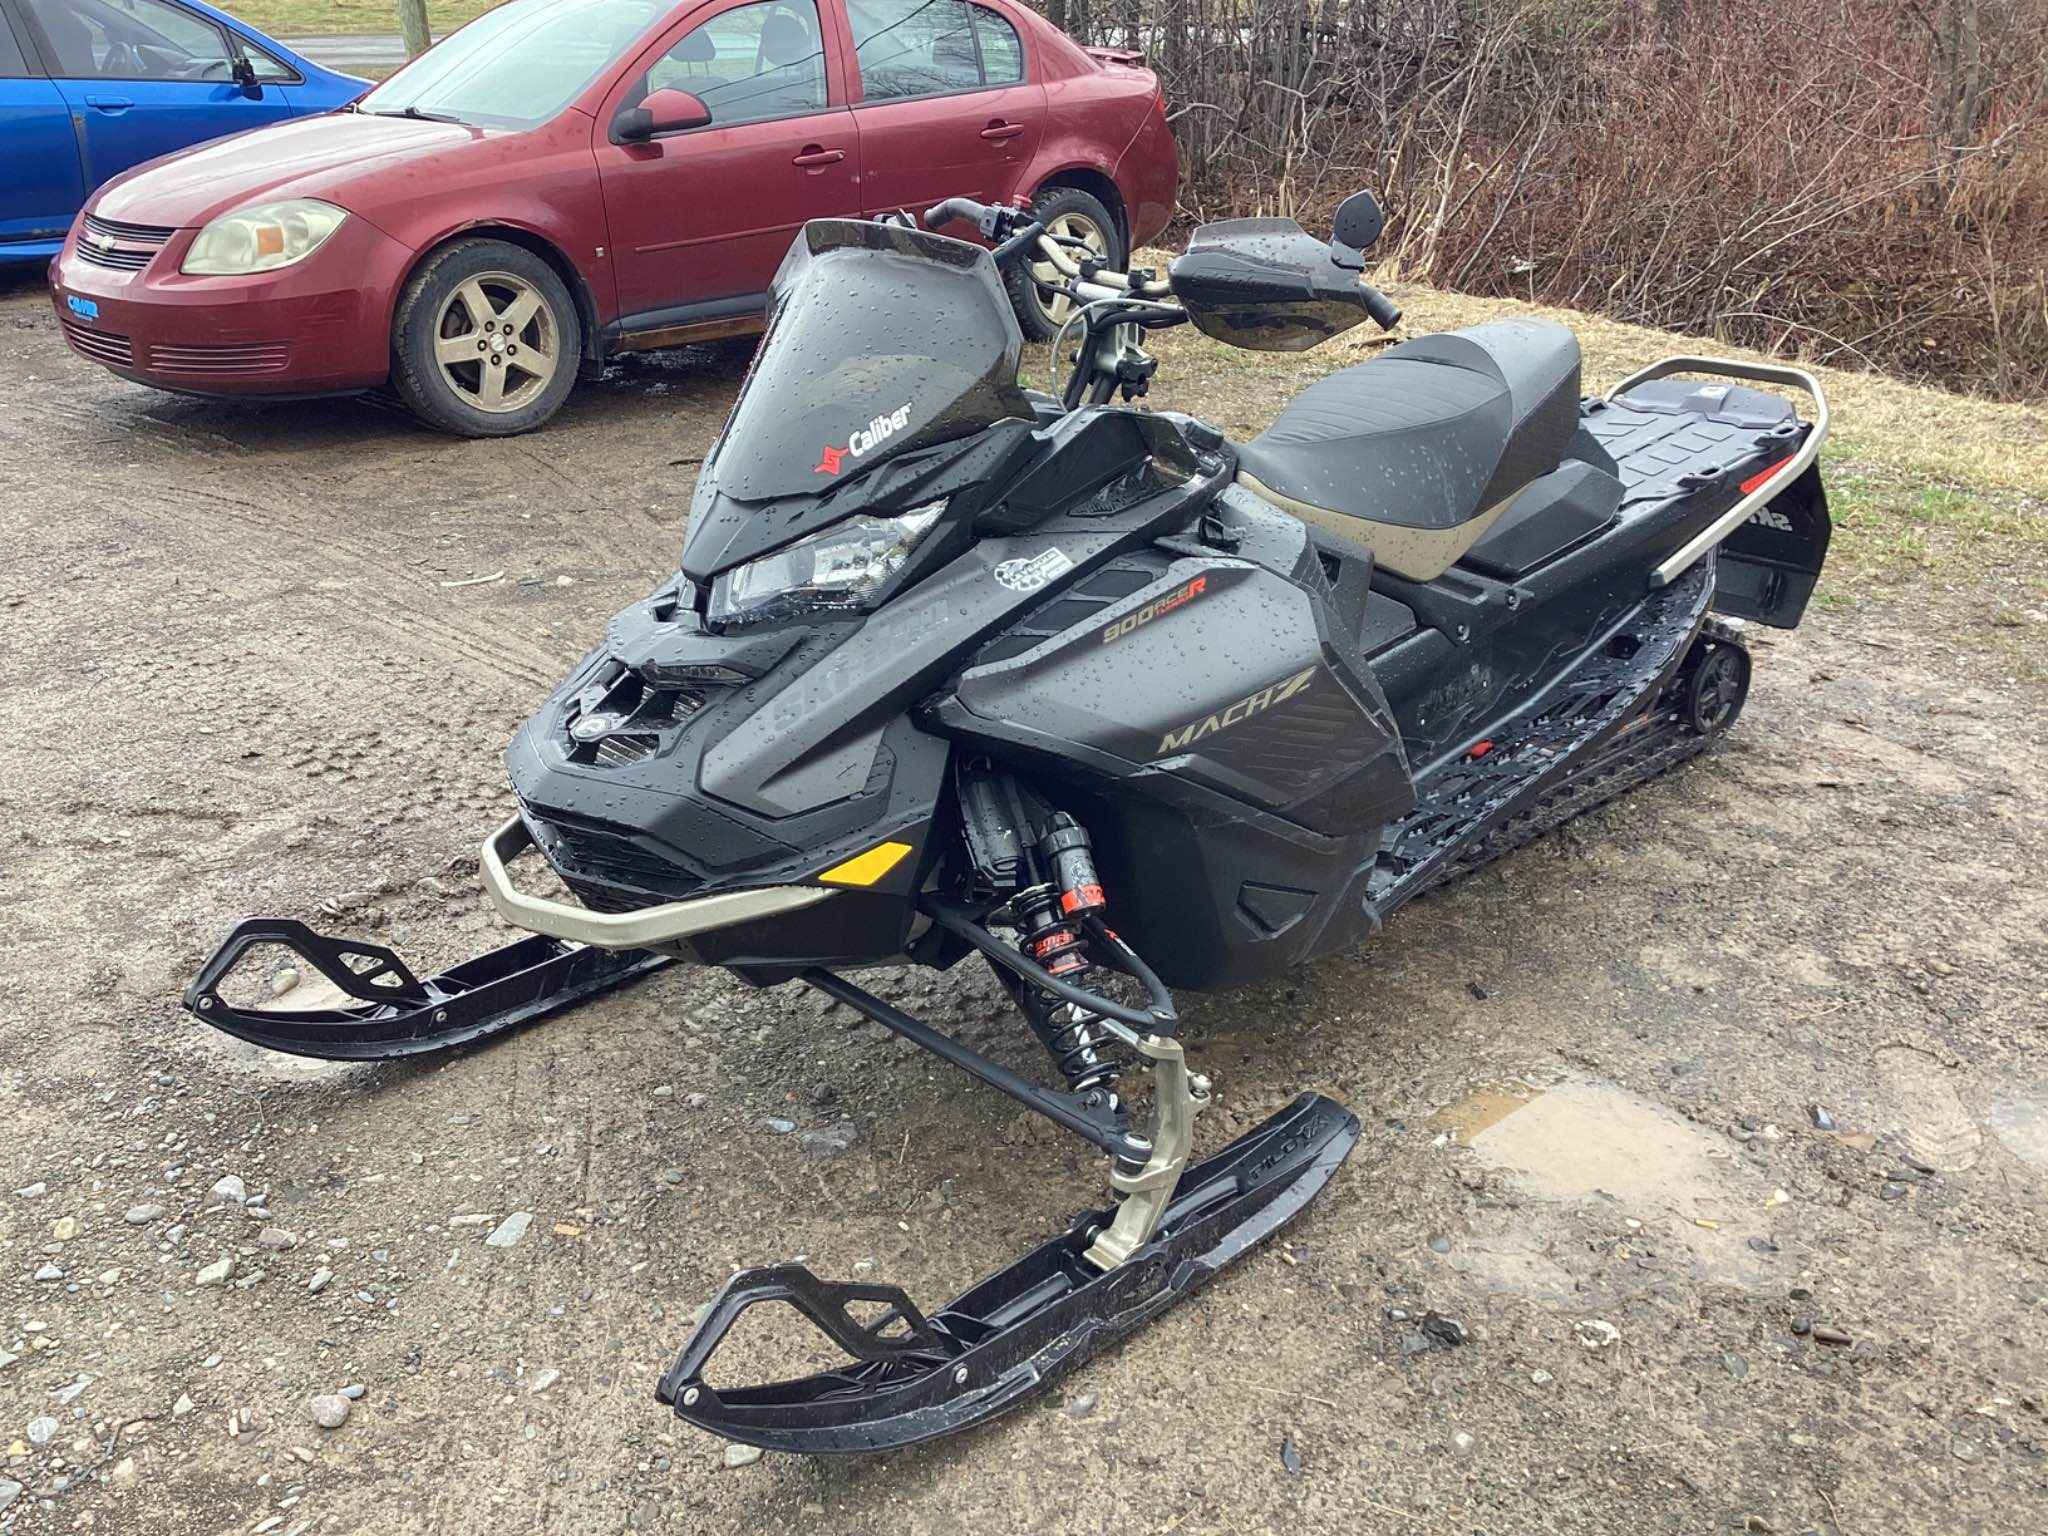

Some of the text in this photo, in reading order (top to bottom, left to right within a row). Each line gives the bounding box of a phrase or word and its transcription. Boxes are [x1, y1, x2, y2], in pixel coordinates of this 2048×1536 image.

[848, 402, 912, 458] Caliber
[1103, 604, 1154, 643] 900
[1187, 577, 1206, 599] R
